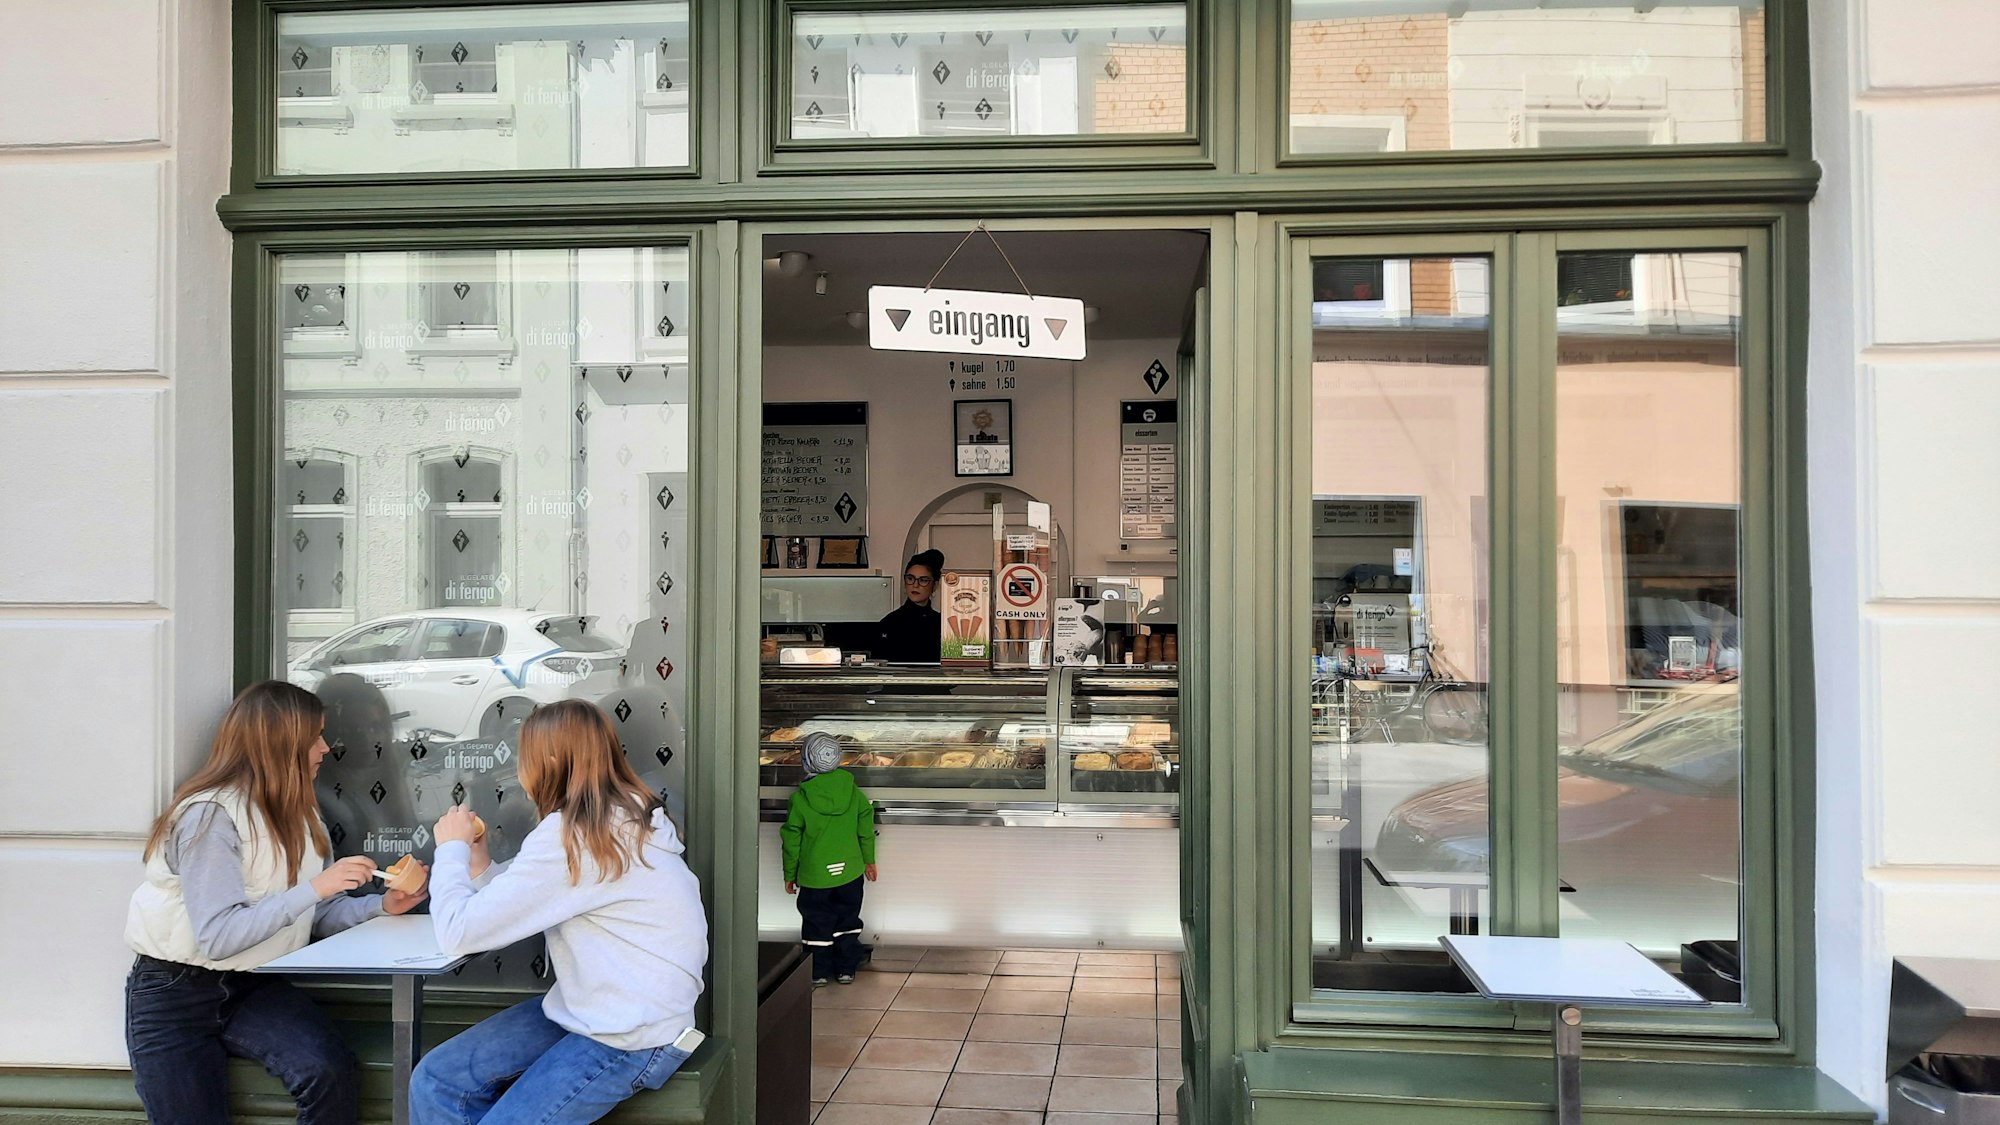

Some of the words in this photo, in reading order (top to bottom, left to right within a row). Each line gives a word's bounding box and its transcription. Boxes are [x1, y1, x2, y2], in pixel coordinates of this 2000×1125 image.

[965, 67, 977, 88] di
[981, 69, 1014, 92] ferig
[523, 84, 534, 104] di
[928, 300, 1031, 348] eingang
[364, 328, 376, 349] di
[379, 330, 414, 352] ferigo
[526, 324, 537, 345] di
[541, 326, 576, 349] ferigo
[961, 361, 984, 375] kugel
[962, 378, 987, 390] sahne
[445, 410, 456, 431] di
[460, 412, 495, 434] ferigo
[365, 494, 376, 516] di
[379, 497, 414, 519] ferigo
[526, 493, 537, 515] di
[541, 496, 576, 518] ferigo
[445, 578, 456, 599] di
[459, 580, 494, 603] ferigo
[996, 610, 1020, 618] CASH
[1023, 610, 1046, 618] ONLY
[1356, 608, 1363, 619] di
[1365, 608, 1386, 622] ferigo
[526, 664, 537, 684] di
[541, 665, 576, 688] ferigo
[444, 747, 456, 768] di
[458, 749, 494, 772] ferigo
[363, 831, 375, 852] di
[378, 833, 413, 857] ferigo
